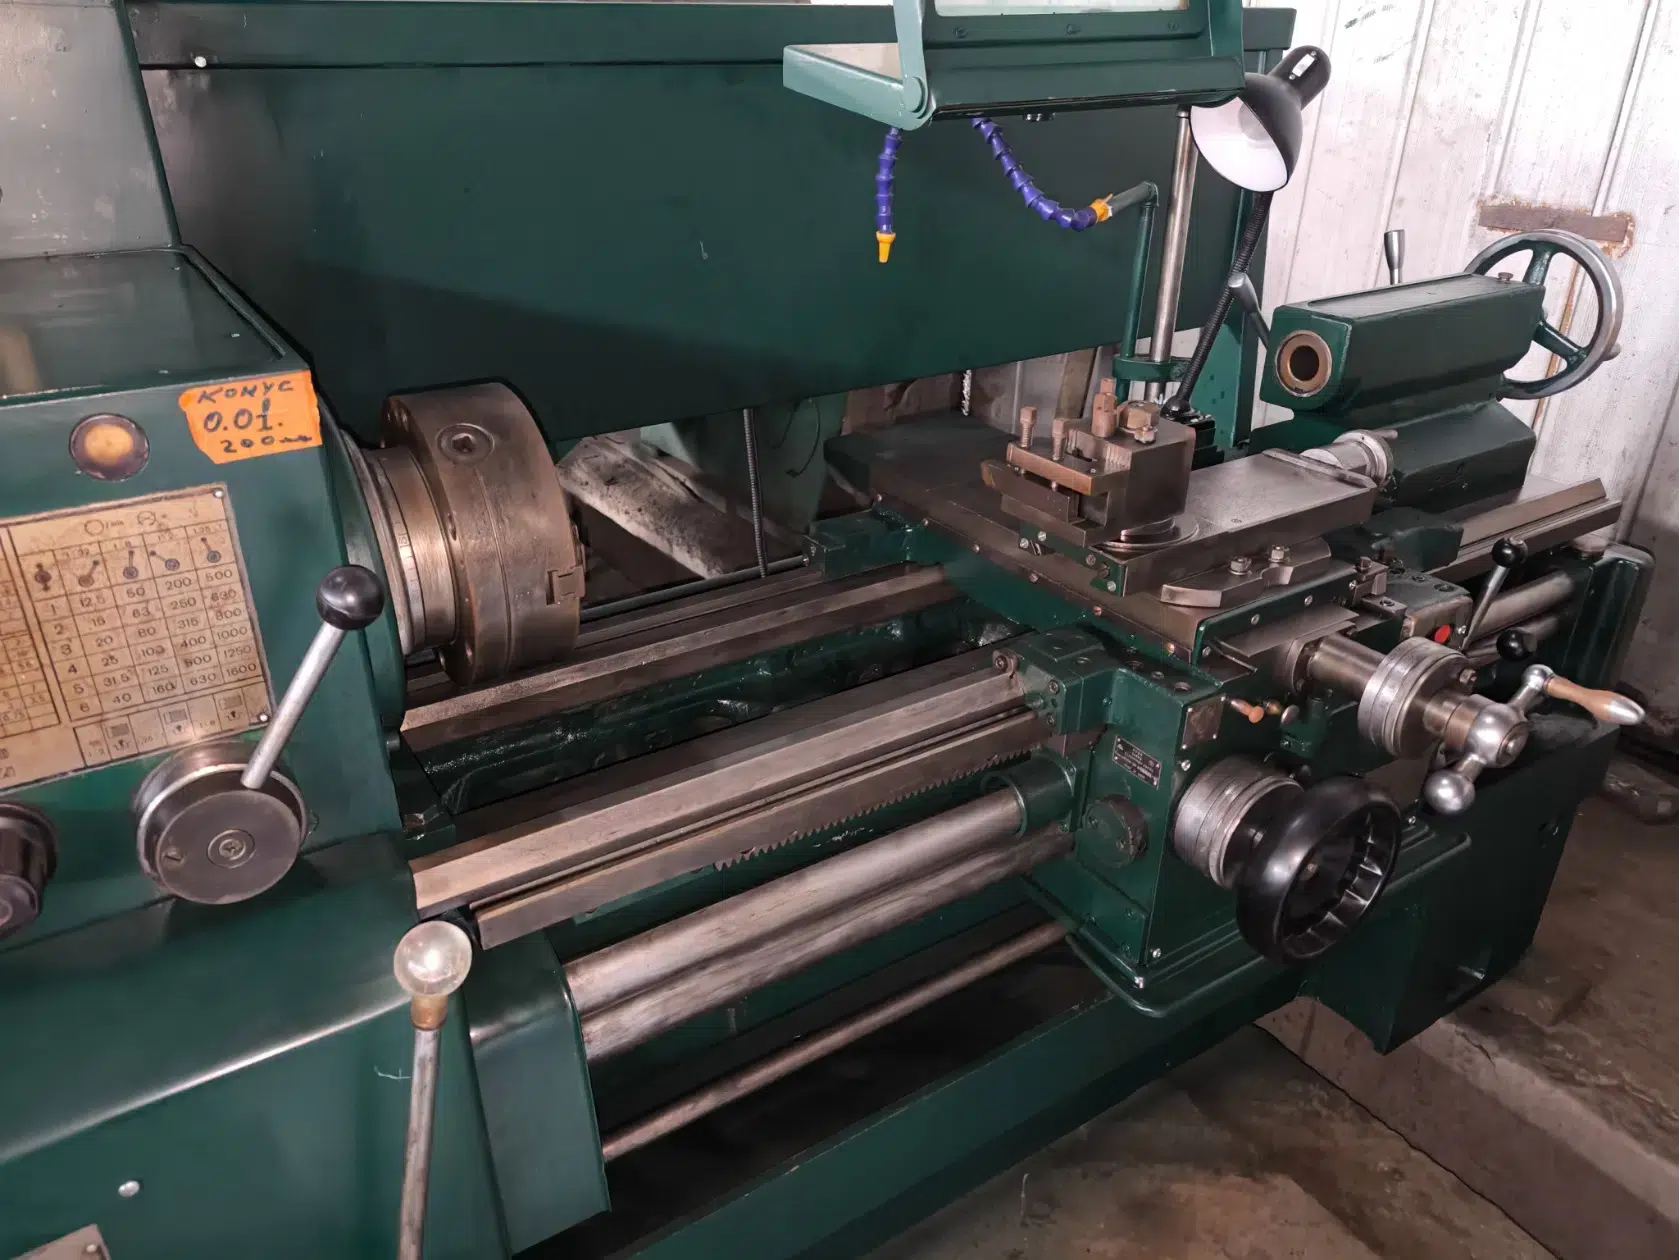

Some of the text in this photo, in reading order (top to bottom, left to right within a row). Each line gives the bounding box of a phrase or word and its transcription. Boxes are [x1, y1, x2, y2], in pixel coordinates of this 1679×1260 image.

[126, 587, 146, 598] 50
[165, 577, 192, 590] 200
[205, 569, 232, 581] 500
[55, 623, 64, 635] 2
[132, 606, 151, 618] 63
[170, 597, 197, 610] 250
[210, 588, 237, 601] 630
[61, 607, 242, 655] 3 20 80 315 800
[73, 683, 84, 694] 5
[148, 665, 169, 677] 125
[223, 645, 252, 659] 1250
[101, 654, 118, 667] 25
[180, 635, 207, 649] 400
[216, 626, 248, 640] 1000
[80, 702, 90, 713] 6
[113, 692, 132, 703] 40
[190, 672, 217, 686] 630
[226, 662, 257, 677] 1600
